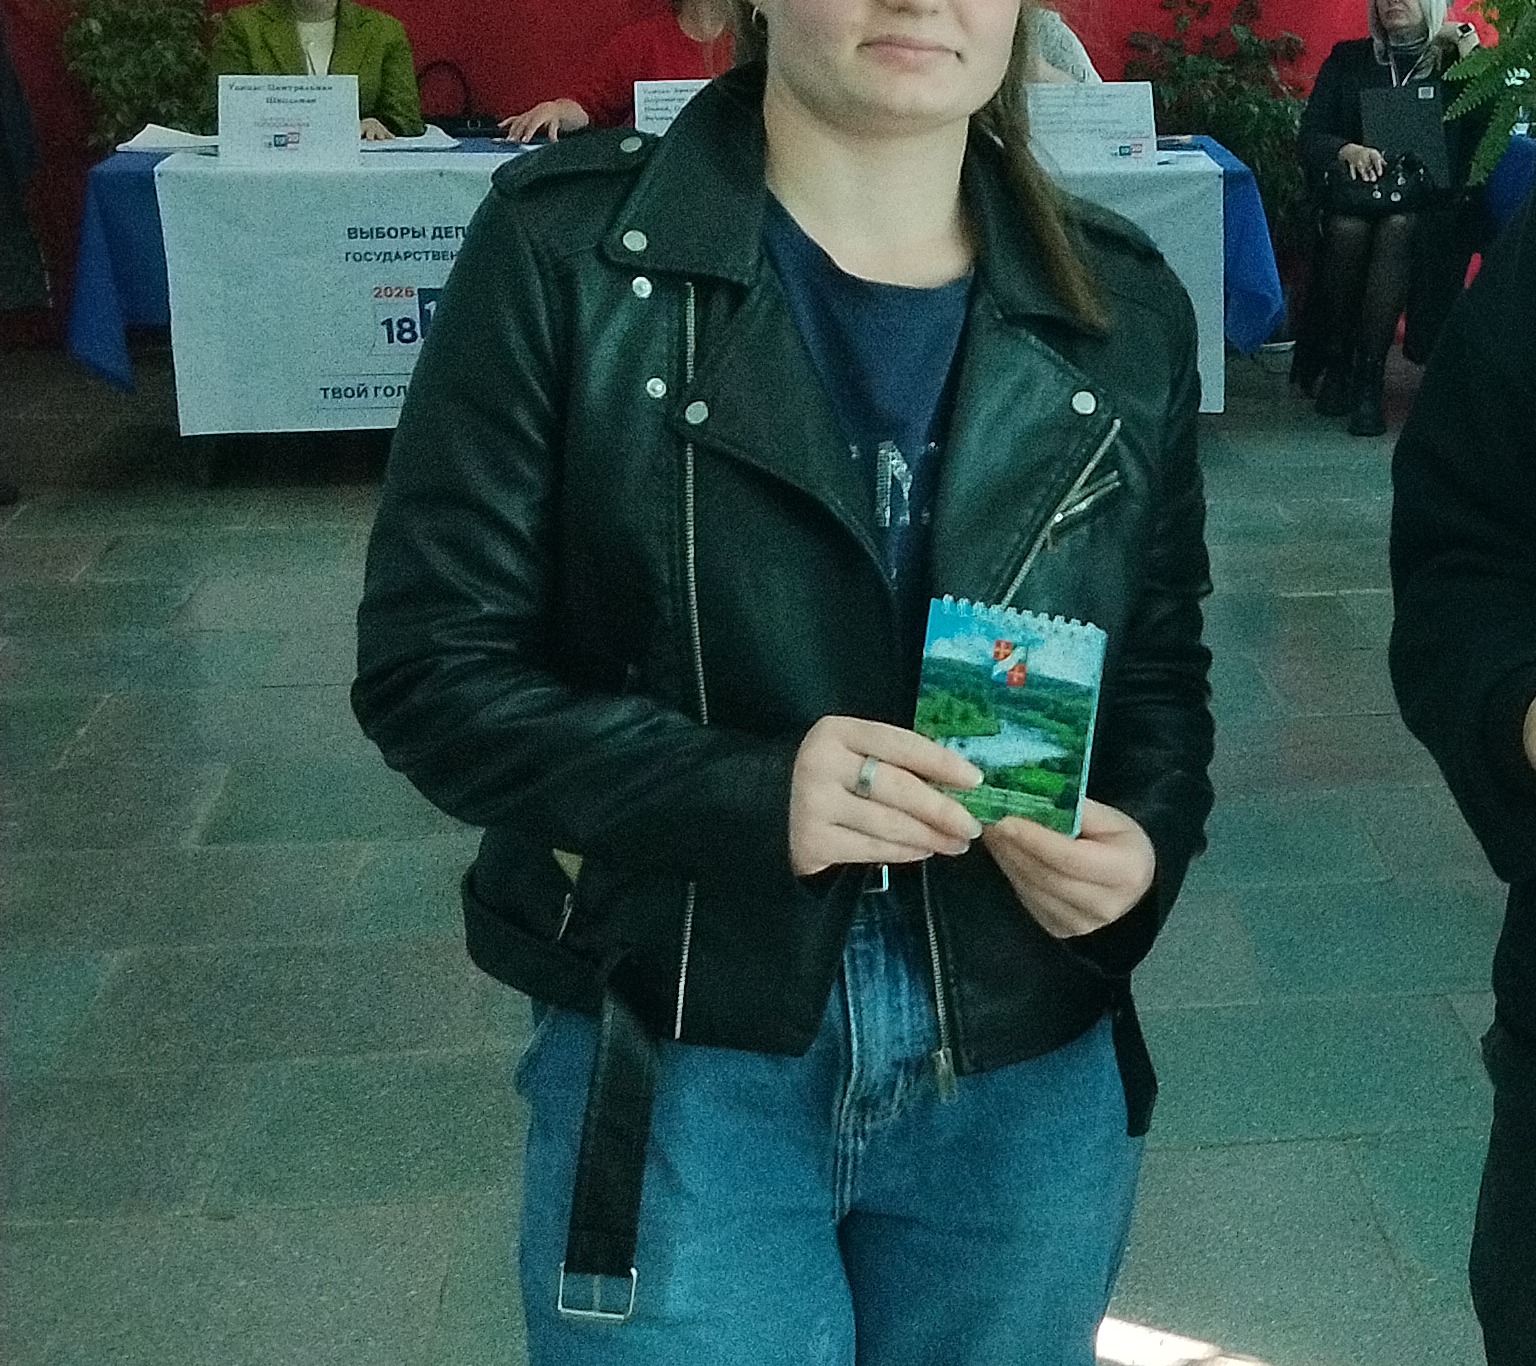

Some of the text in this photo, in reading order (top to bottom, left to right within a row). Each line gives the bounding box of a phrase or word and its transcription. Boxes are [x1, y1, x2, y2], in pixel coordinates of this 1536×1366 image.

[347, 226, 426, 239] ВЫБОРЫ
[373, 286, 415, 298] 2026
[381, 317, 418, 344] 18
[319, 382, 368, 399] ТВОЙ
